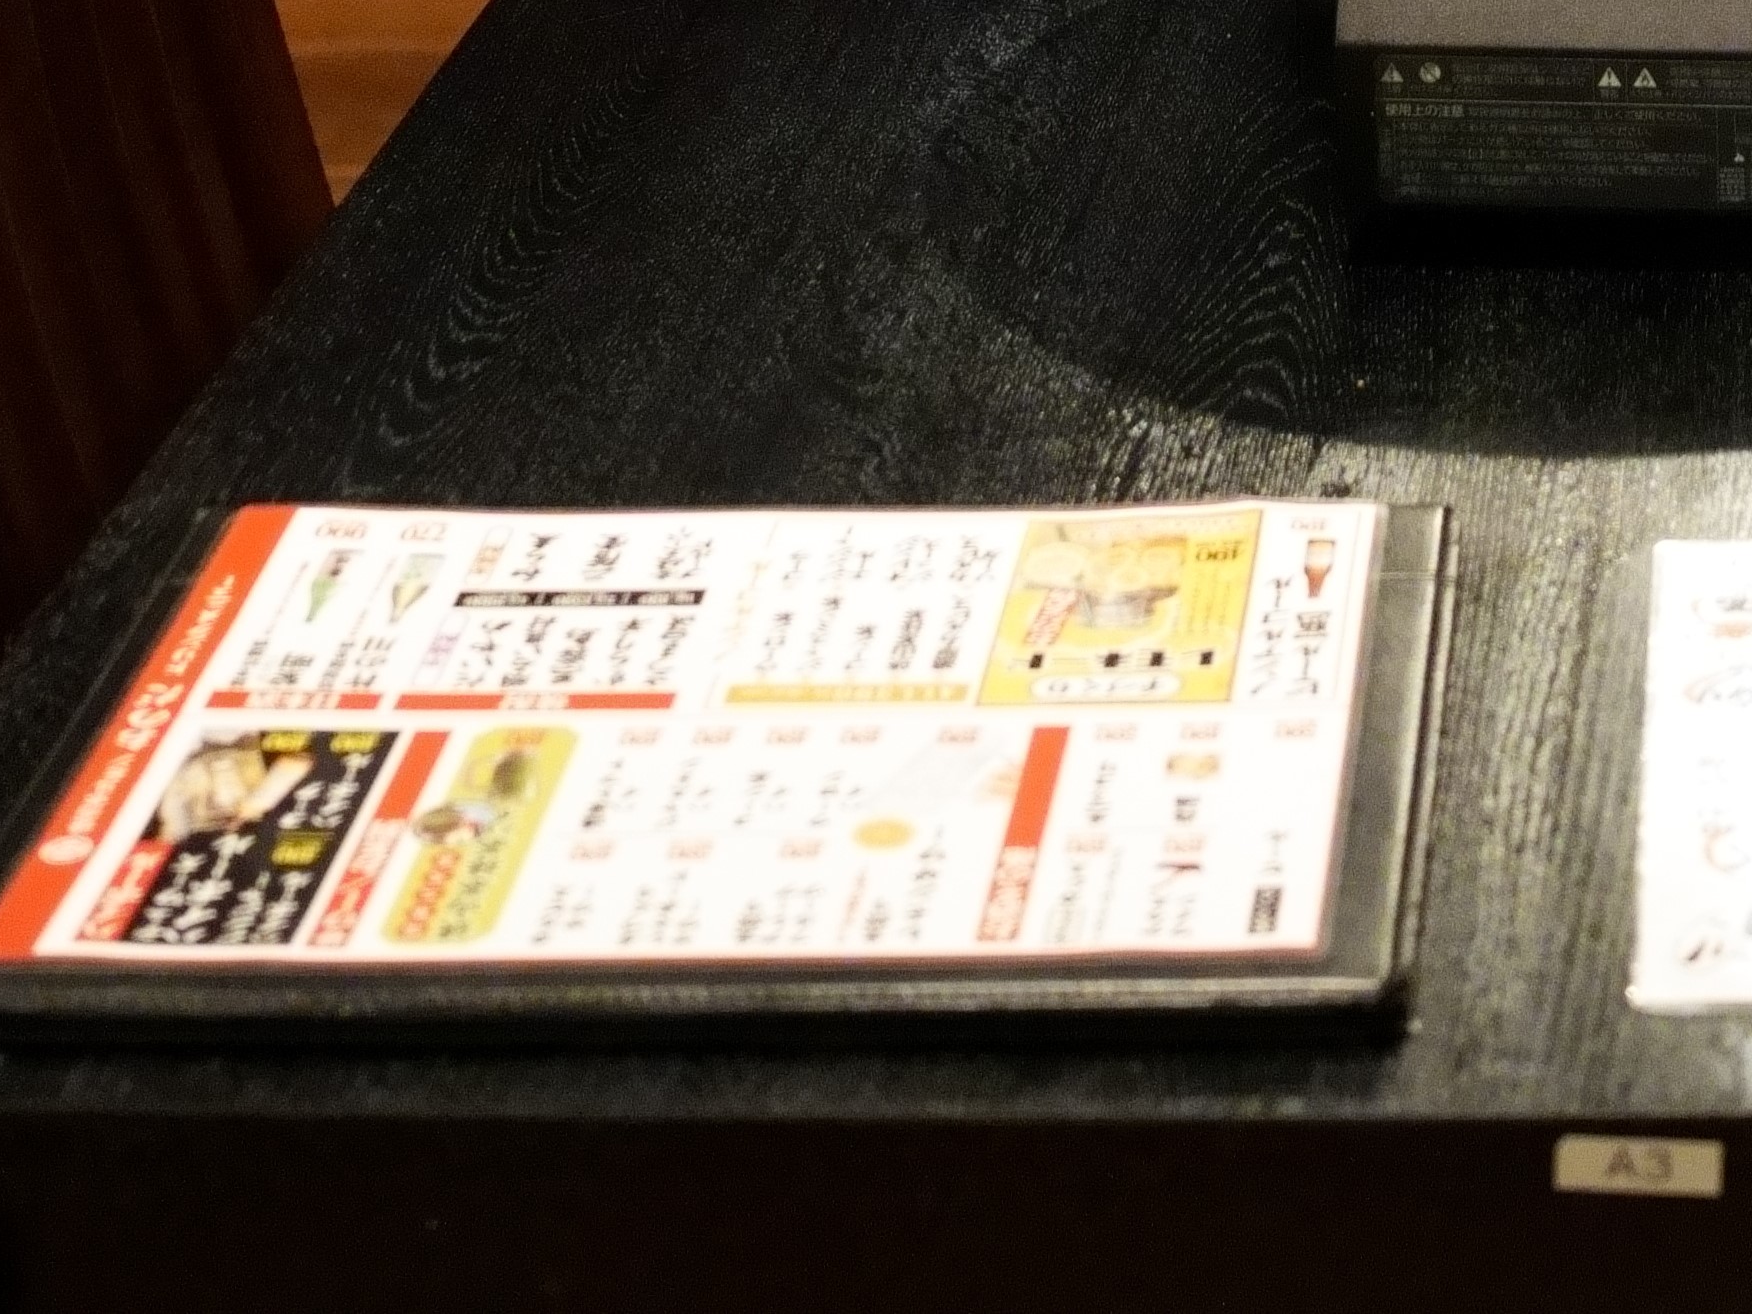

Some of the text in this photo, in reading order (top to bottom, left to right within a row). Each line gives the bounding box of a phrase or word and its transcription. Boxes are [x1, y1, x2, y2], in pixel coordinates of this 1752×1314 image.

[1385, 104, 1465, 118] 使用上の注意
[1607, 1144, 1674, 1180] A3
